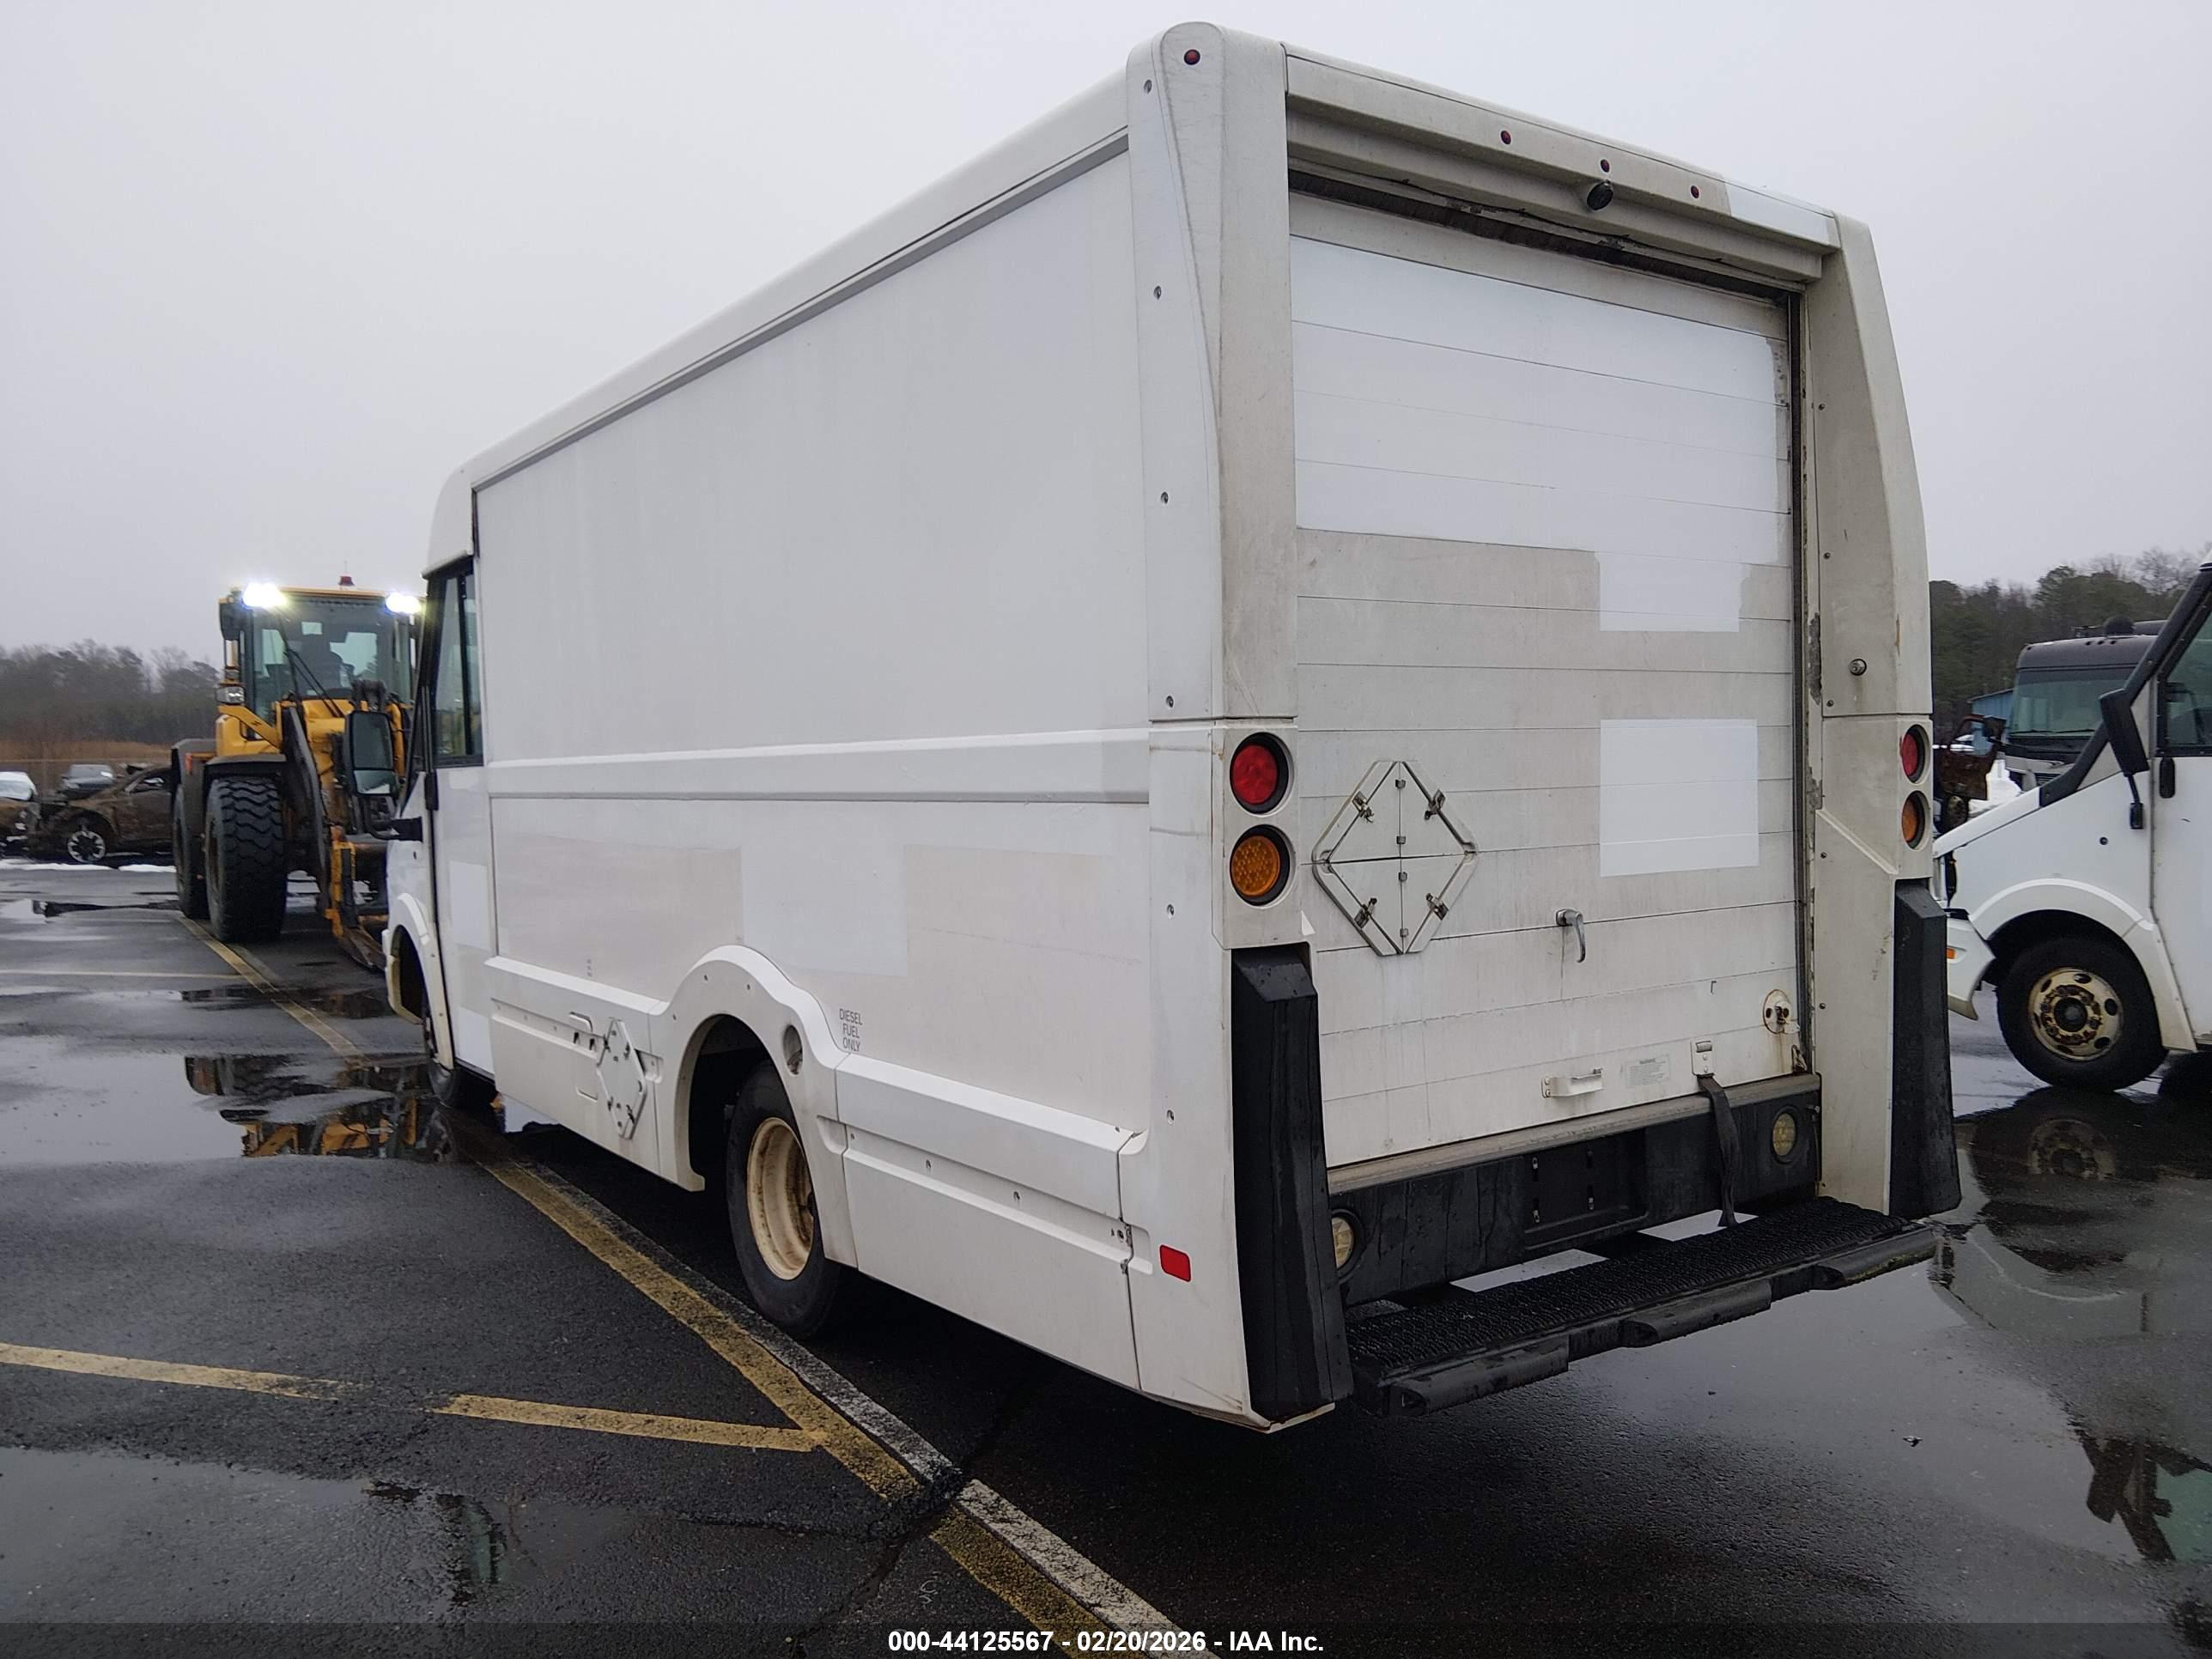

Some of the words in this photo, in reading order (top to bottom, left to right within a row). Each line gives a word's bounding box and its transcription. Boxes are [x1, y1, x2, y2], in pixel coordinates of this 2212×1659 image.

[839, 1008, 863, 1025] DIESEL
[842, 1023, 860, 1038] FUEL
[842, 1036, 860, 1052] ONLY
